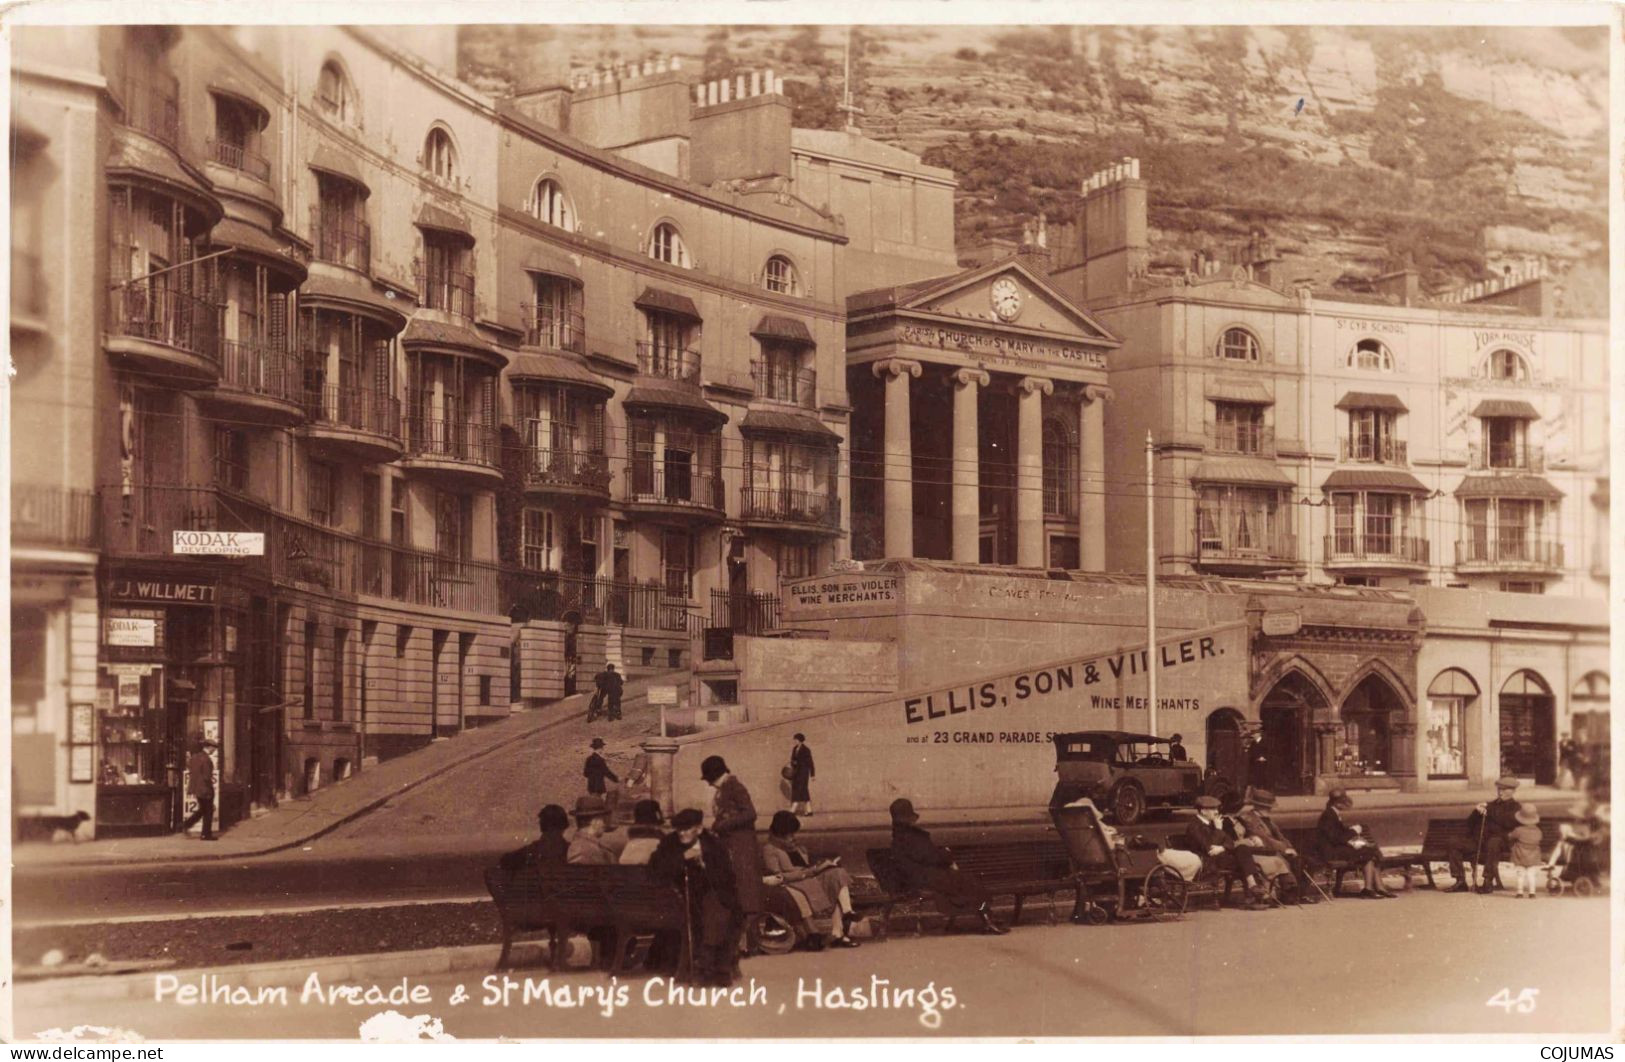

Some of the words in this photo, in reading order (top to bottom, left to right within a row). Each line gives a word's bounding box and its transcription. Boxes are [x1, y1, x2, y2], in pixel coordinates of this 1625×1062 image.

[938, 329, 983, 346] CHURCH
[1007, 340, 1034, 353] MARY
[175, 531, 239, 547] KODAK
[181, 546, 250, 554] DEVELOPING
[137, 582, 216, 601] WILLMETT
[821, 583, 839, 593] SON
[861, 579, 897, 591] VIDLER
[800, 594, 822, 605] WINE
[828, 590, 895, 604] MERCHANTS.
[904, 681, 1007, 725] ELLIS,
[1014, 665, 1074, 700] SON
[1084, 661, 1101, 685] &
[1126, 695, 1200, 711] MERHANTS
[934, 731, 949, 744] 23
[953, 731, 995, 744] GRAND
